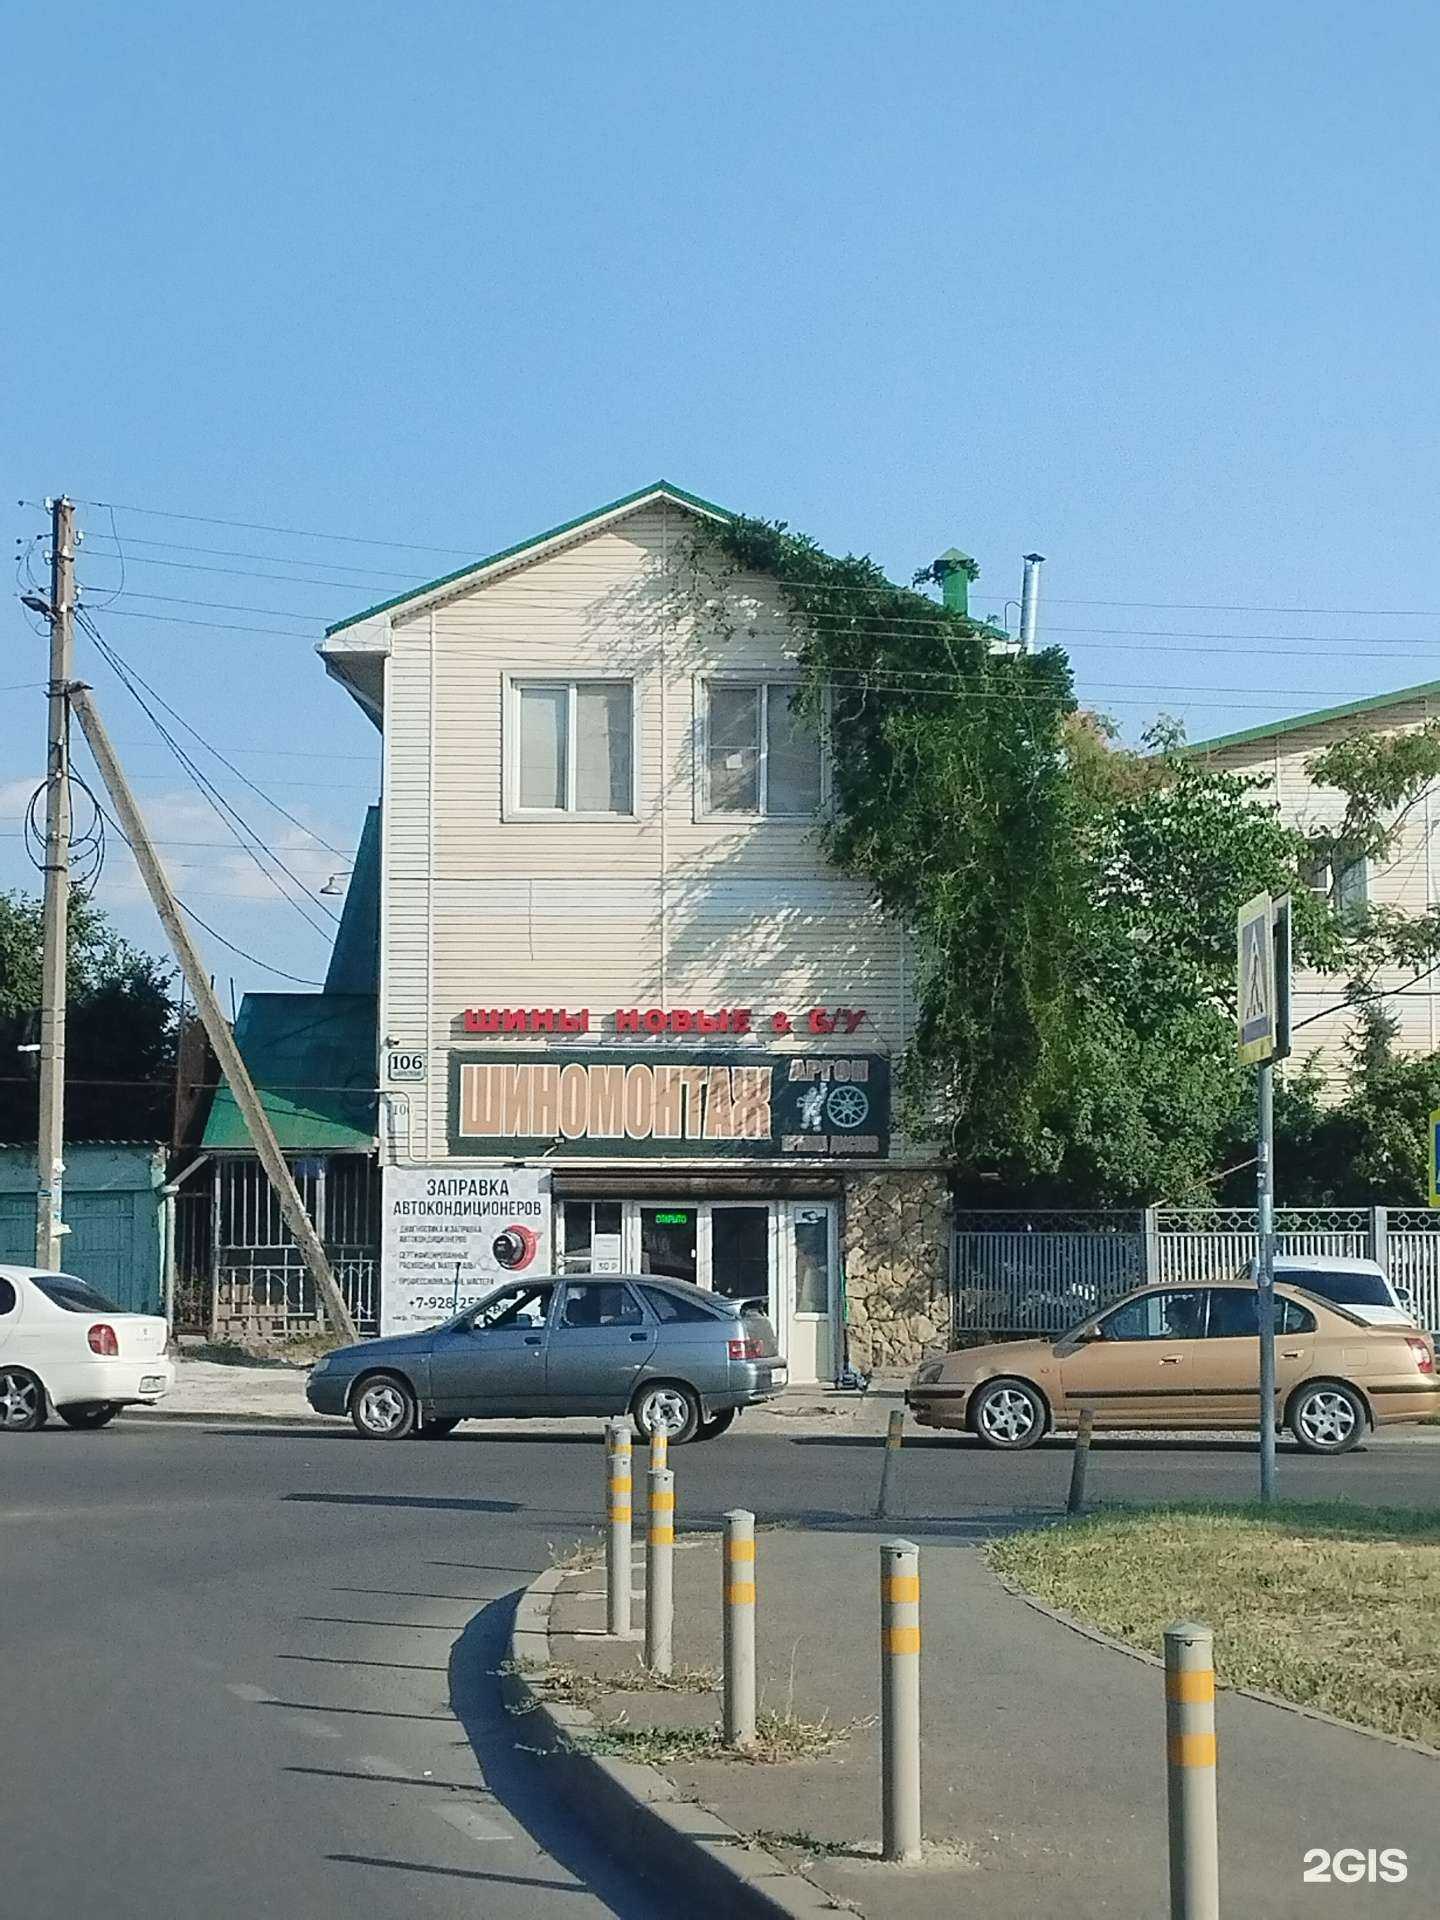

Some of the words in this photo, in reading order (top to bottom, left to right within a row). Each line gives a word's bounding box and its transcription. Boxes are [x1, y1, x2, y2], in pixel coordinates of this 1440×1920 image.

[463, 1009, 589, 1032] ШИНЫ
[616, 1008, 751, 1032] НОВЫЕ
[808, 1008, 866, 1032] Б/У
[392, 1056, 423, 1070] 106
[788, 1058, 869, 1082] АРГОН
[459, 1063, 773, 1140] ШИНОМОНТАЖ
[427, 1179, 510, 1196] ЗАПРАВКА
[393, 1201, 542, 1217] АВТОКОНДИЦИОНЕРОВ
